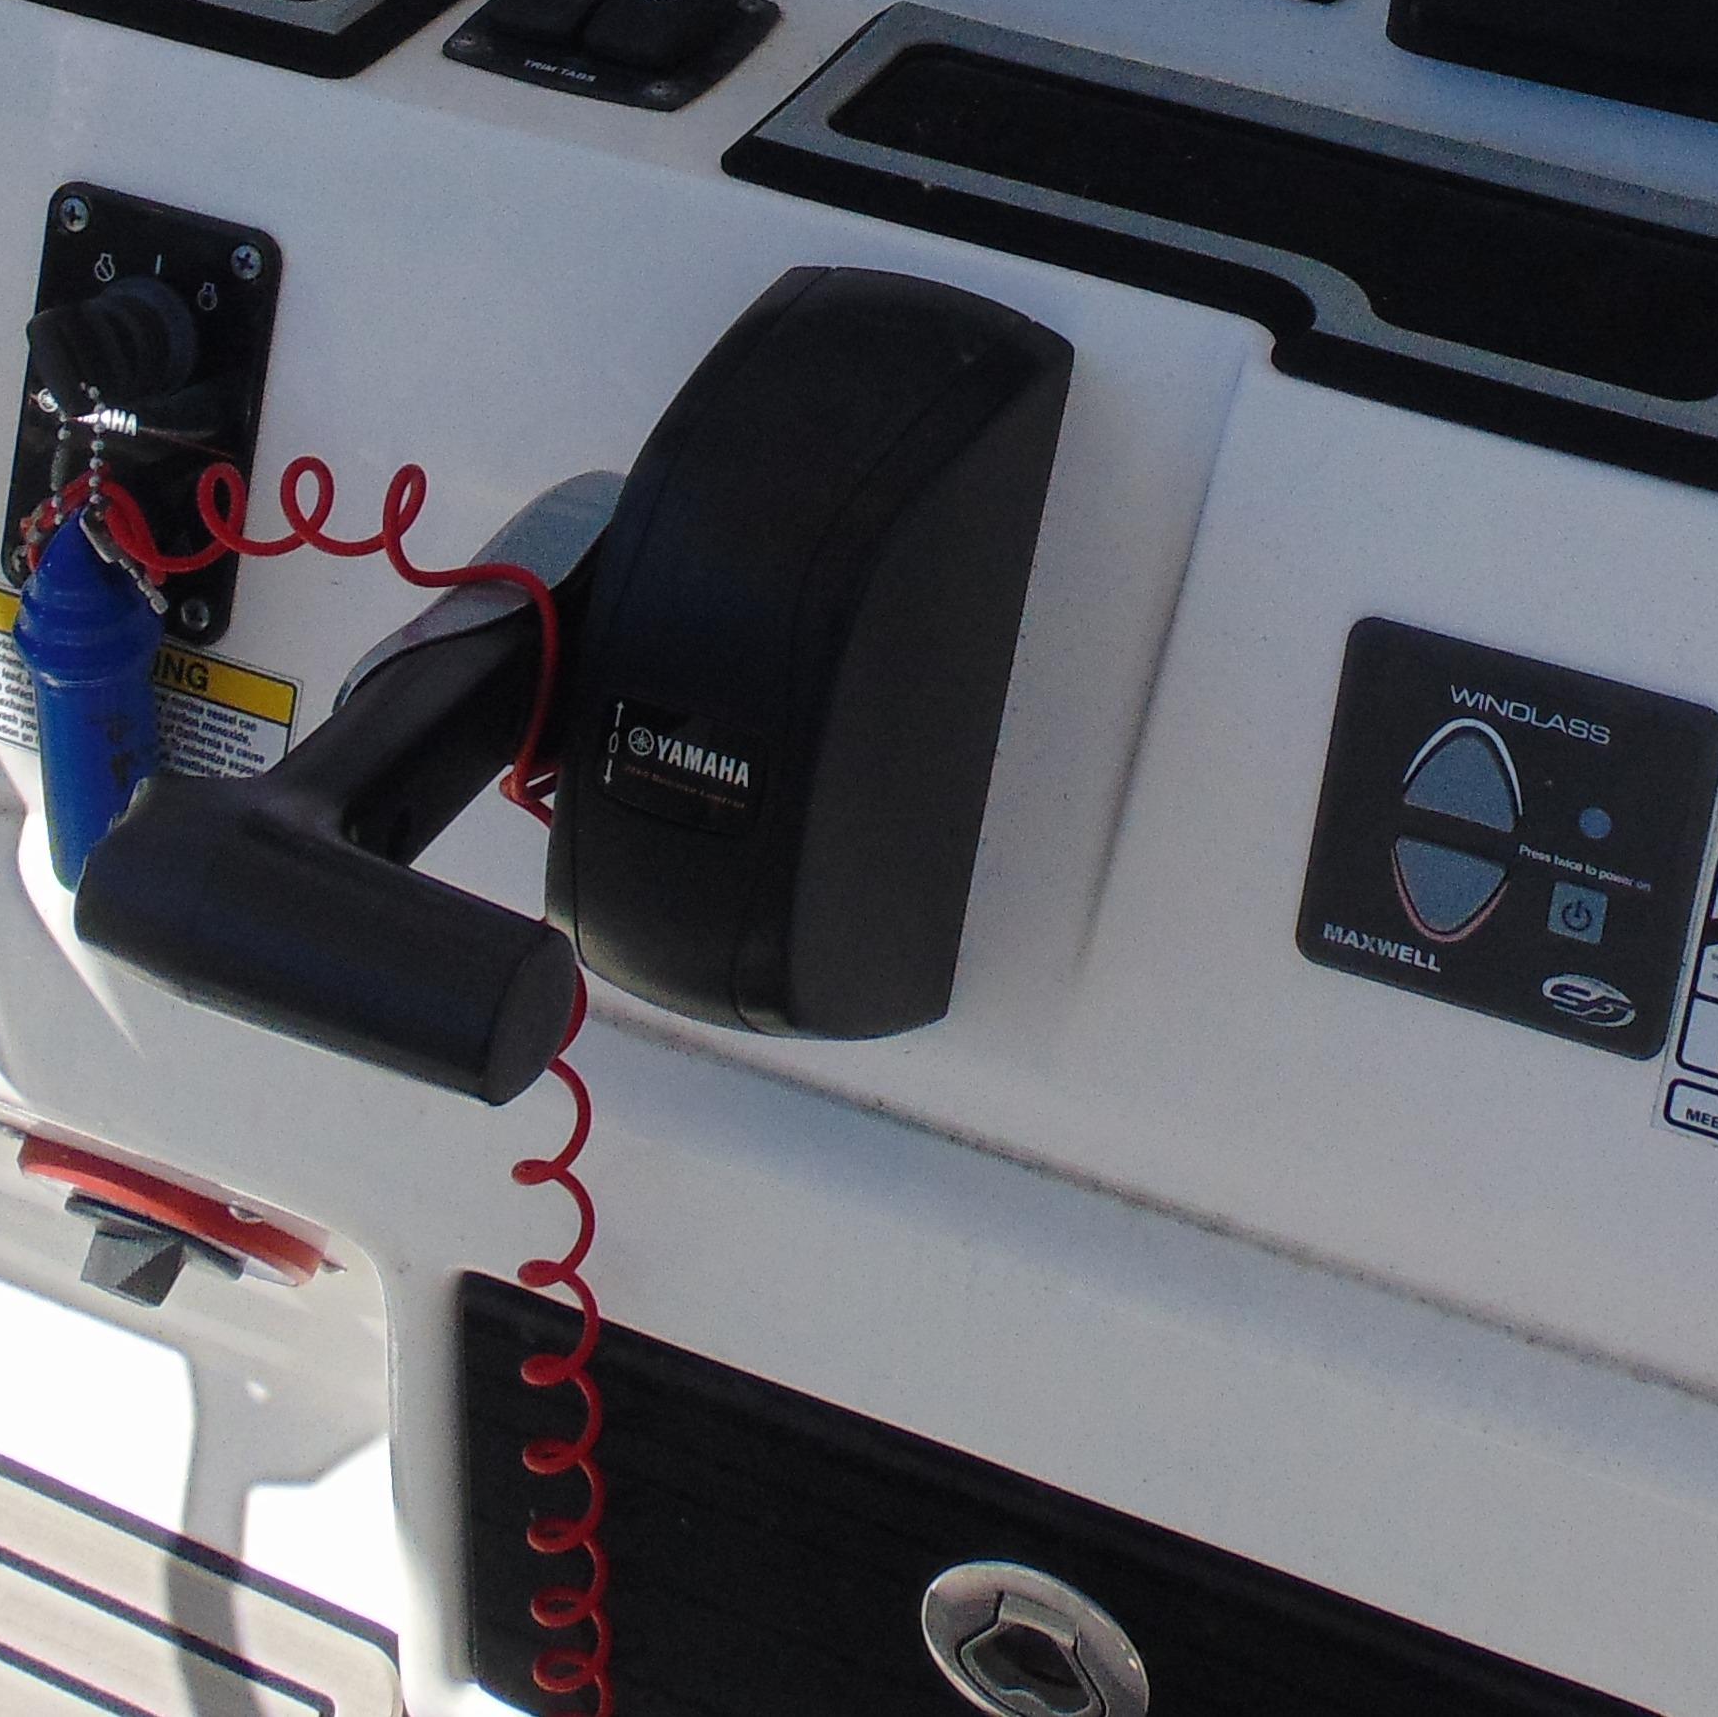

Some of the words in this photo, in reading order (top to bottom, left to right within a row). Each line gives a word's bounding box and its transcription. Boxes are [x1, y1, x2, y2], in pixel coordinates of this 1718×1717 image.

[524, 58, 557, 74] TRIM
[560, 67, 598, 82] TABS
[1449, 684, 1612, 746] WINDLASS
[657, 734, 751, 789] YAMAHA
[1519, 844, 1551, 863] Press
[1554, 854, 1583, 872] twice
[1585, 864, 1597, 876] to
[1598, 869, 1634, 886] power
[1636, 880, 1651, 892] on
[1321, 922, 1442, 973] MAXWELL
